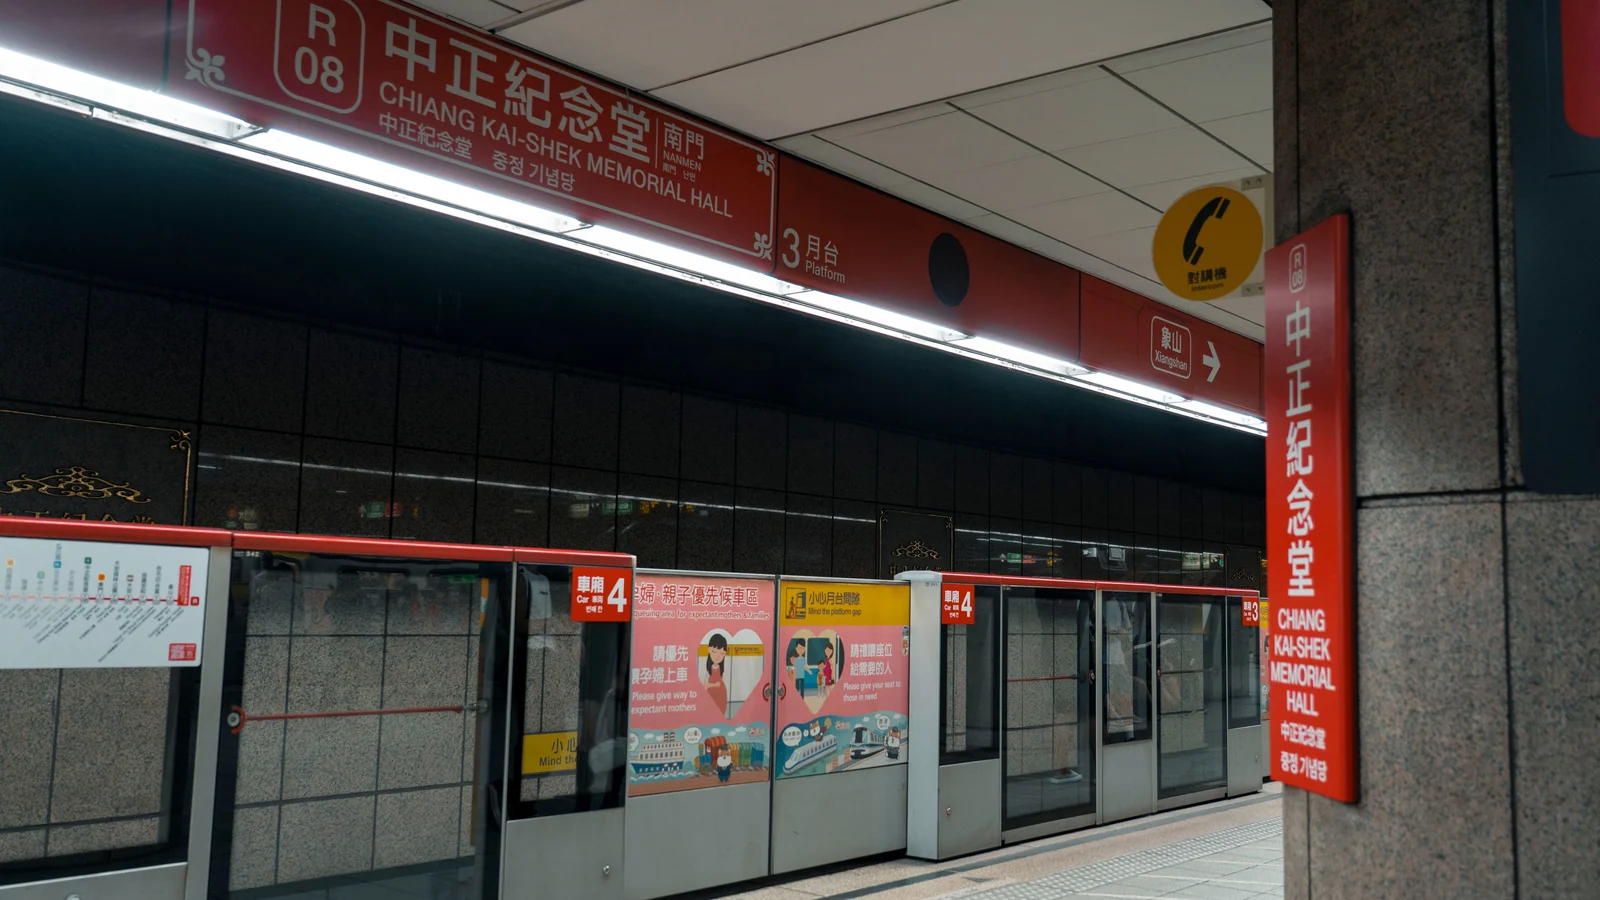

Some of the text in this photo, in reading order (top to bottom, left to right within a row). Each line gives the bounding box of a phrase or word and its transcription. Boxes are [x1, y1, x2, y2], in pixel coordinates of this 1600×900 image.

[308, 3, 337, 47] R
[294, 46, 344, 94] 08
[385, 18, 650, 163] 中正紀念堂
[378, 111, 473, 160] 中正紀念堂
[663, 122, 704, 160] 南門
[379, 81, 733, 218] CHIANG KAI-SHEK MEMORIAL HALL
[663, 150, 702, 172] NANMEN
[491, 150, 575, 192] 중정 기념당
[782, 228, 800, 269] 3
[805, 234, 839, 266] 月台
[1293, 252, 1301, 267] R
[805, 260, 846, 284] Platform
[1187, 267, 1228, 285] 對講機
[1291, 269, 1304, 287] 08
[1191, 282, 1225, 293] Intercom
[1161, 326, 1182, 353] 象山
[1154, 350, 1188, 372] Xiangshan
[1285, 300, 1315, 598] 中正紀念堂
[577, 575, 605, 593] 車廂
[607, 577, 628, 613] 4
[576, 594, 590, 604] Car
[961, 591, 973, 618] 4
[1252, 601, 1259, 622] 3
[634, 608, 770, 621] queuing area for expectant mothers & families
[808, 607, 862, 617] Mind the platform gap
[1277, 607, 1326, 632] CHIANG
[653, 645, 689, 662] 請優先
[1273, 634, 1331, 661] KAI-SHEK
[843, 682, 860, 691] Please
[861, 682, 871, 692] give
[872, 682, 884, 692] your
[884, 681, 895, 690] seat
[1270, 661, 1336, 691] MEMORIAL
[632, 690, 697, 702] Please give way to
[843, 694, 858, 702] those
[864, 692, 878, 701] need
[1286, 690, 1319, 717] HALL
[631, 703, 696, 715] expectant mothers
[1280, 719, 1326, 750] 中正紀念堂
[539, 756, 562, 767] Mind
[1280, 750, 1328, 783] 중정 기념당
